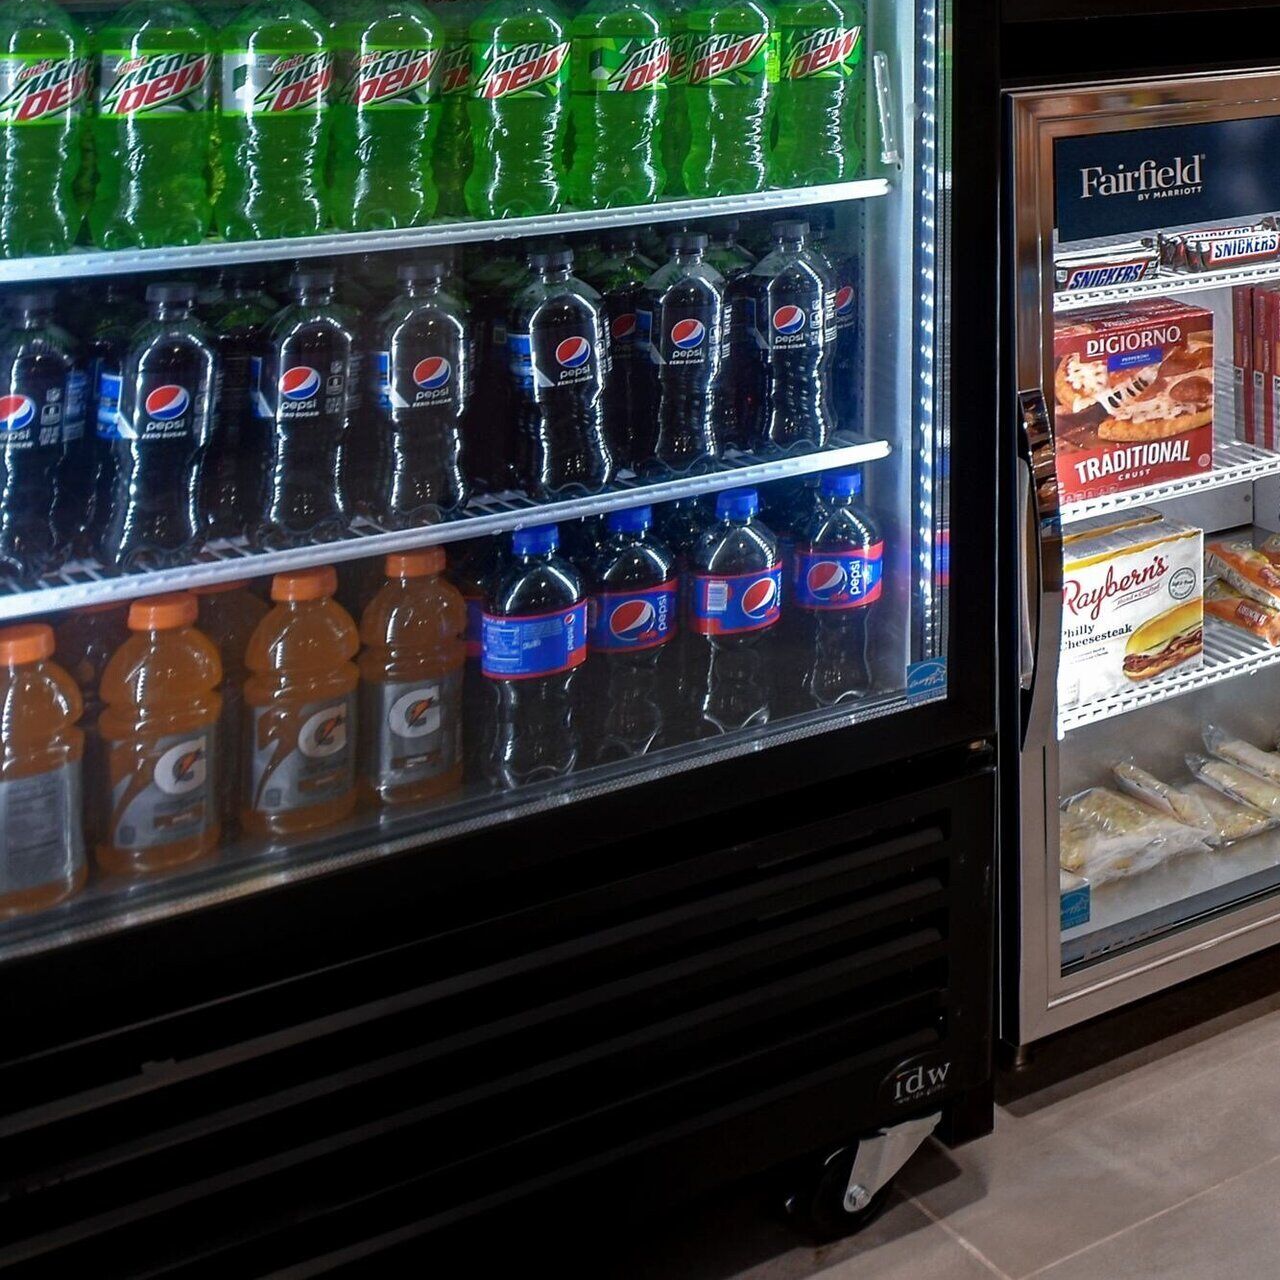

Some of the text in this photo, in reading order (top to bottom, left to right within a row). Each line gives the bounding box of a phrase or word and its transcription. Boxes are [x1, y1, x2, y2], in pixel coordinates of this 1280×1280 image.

[1080, 154, 1202, 199] Fairfield
[1138, 186, 1202, 201] BY MARRIOTT
[1214, 234, 1277, 259] SNICKERS
[560, 364, 591, 381] pepsi
[415, 386, 449, 401] pepsi
[1074, 440, 1190, 484] TRADITIONAL
[1118, 469, 1151, 481] CRUST
[849, 559, 860, 595] pepsi
[1062, 555, 1169, 620] Raybern's
